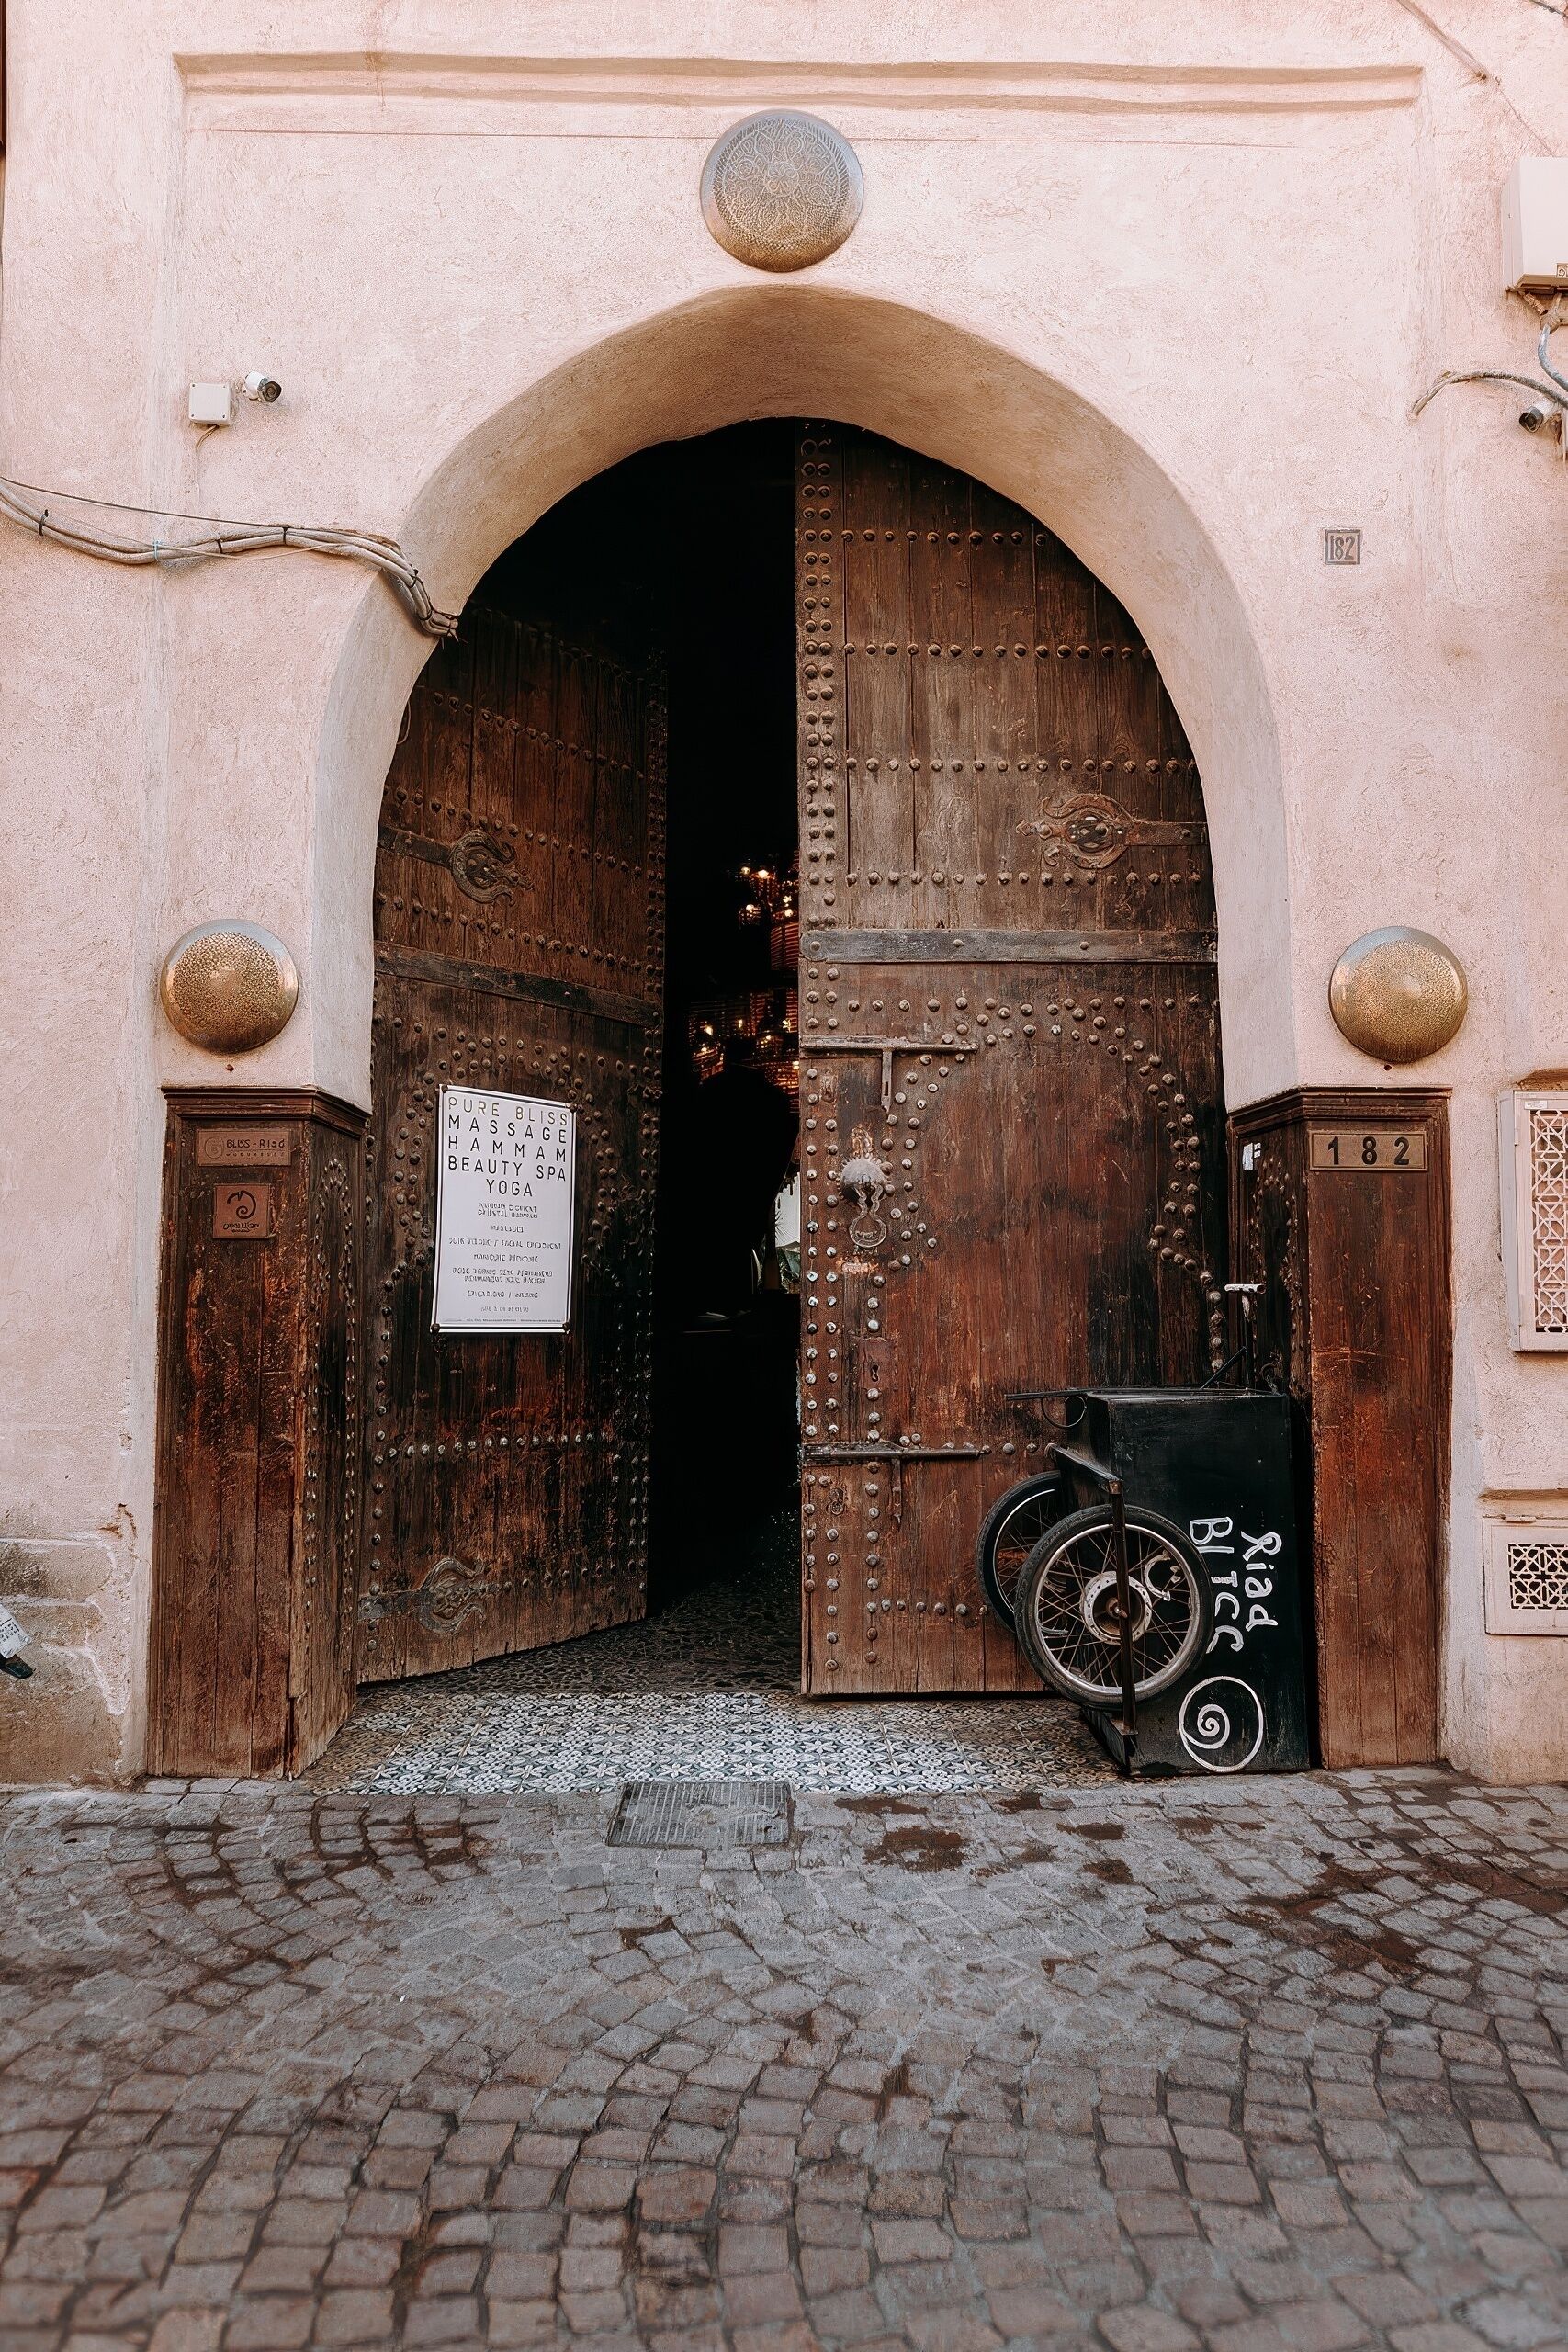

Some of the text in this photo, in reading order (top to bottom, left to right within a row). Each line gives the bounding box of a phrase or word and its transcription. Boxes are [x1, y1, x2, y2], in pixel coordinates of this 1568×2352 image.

[1330, 536, 1355, 560] 182
[448, 1097, 568, 1126] PURE BLISS
[448, 1114, 567, 1144] MASSAGE
[448, 1135, 566, 1163] HAMMAM
[1327, 1136, 1410, 1166] 182
[448, 1155, 566, 1182] BEAUTY SPA
[486, 1179, 533, 1197] YOGA
[1241, 1531, 1282, 1632] Riad
